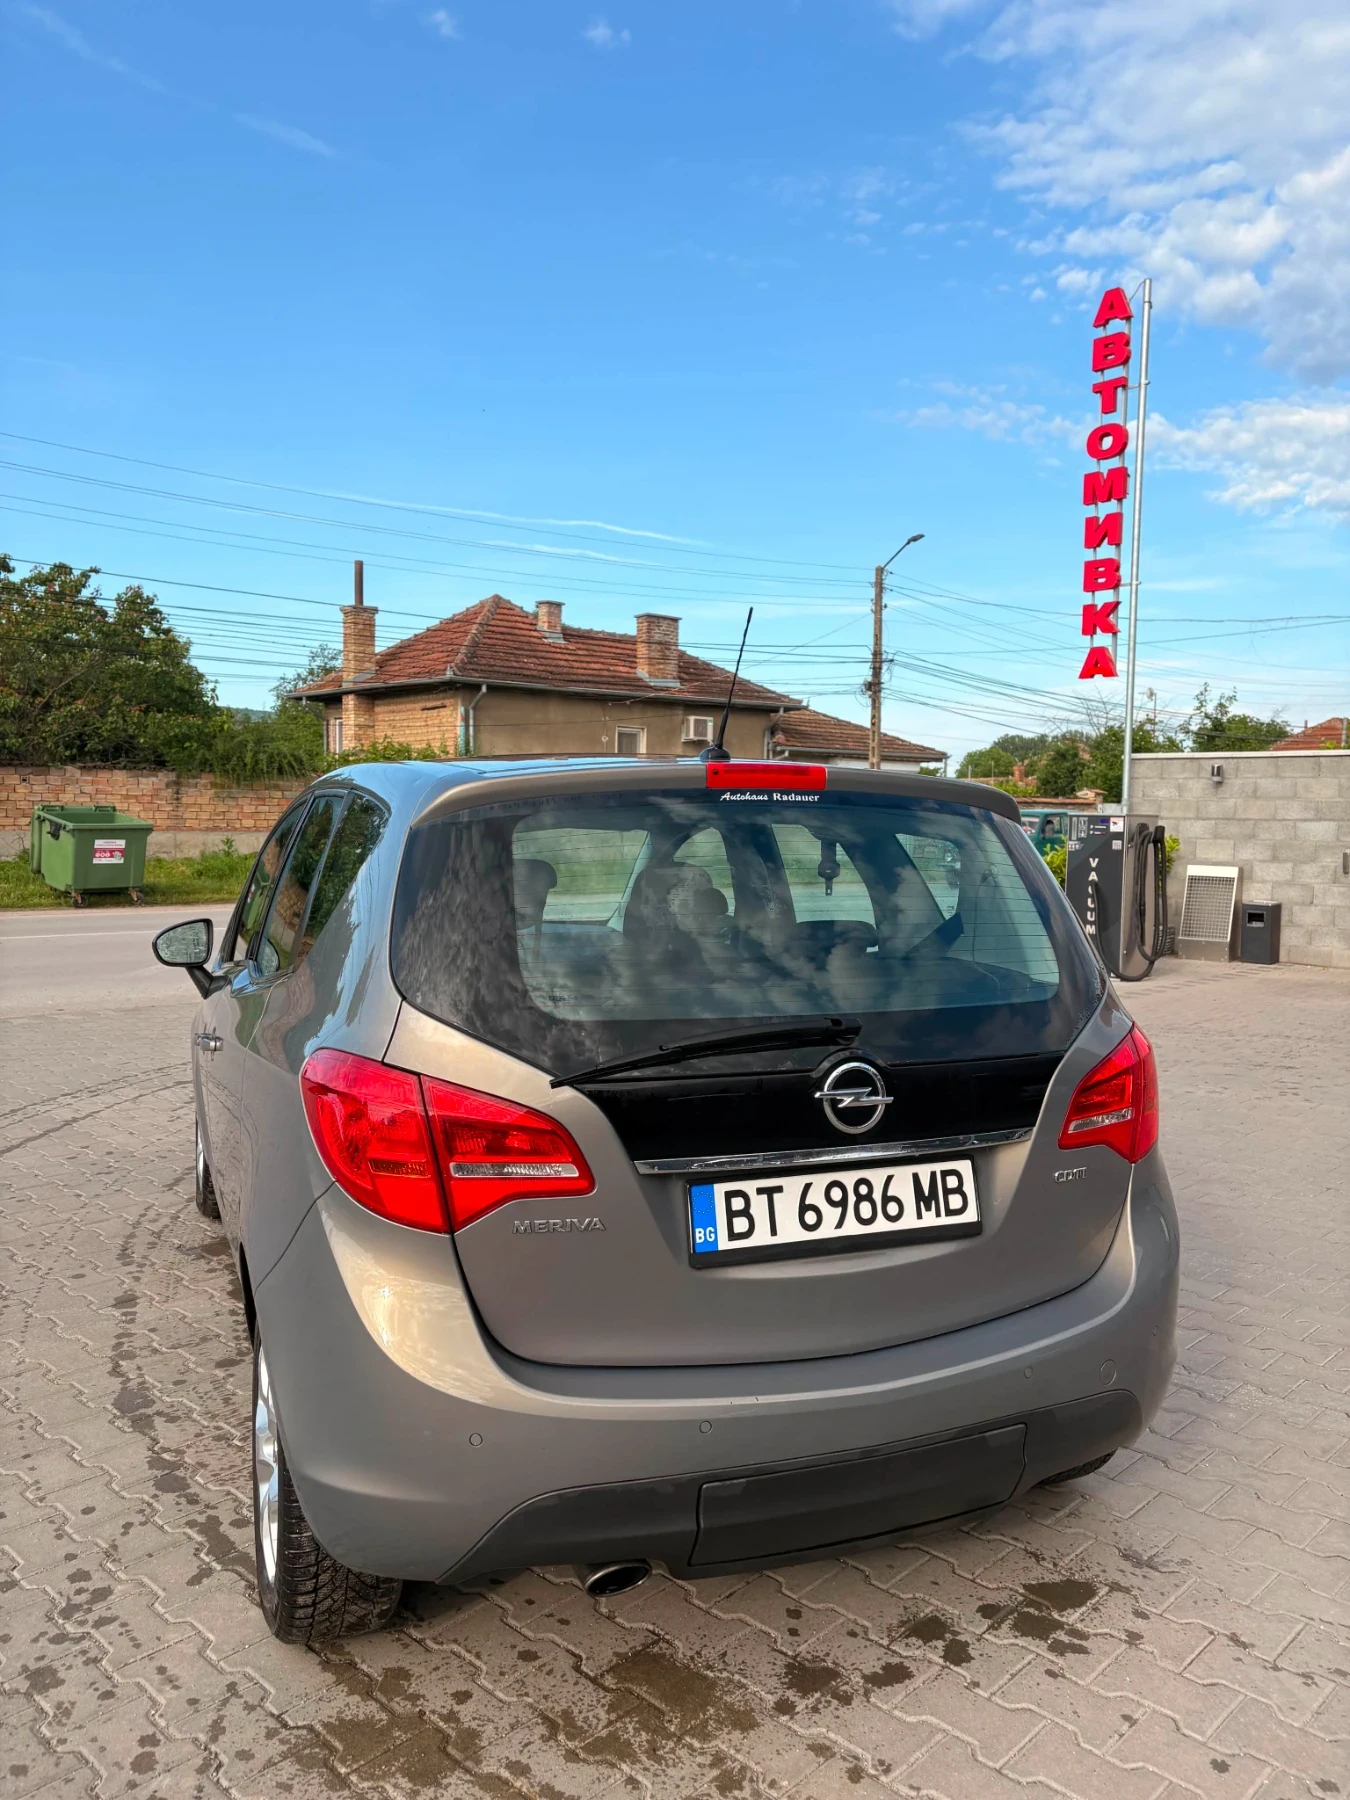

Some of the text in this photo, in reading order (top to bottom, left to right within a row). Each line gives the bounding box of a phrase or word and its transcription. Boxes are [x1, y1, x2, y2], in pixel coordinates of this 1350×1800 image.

[1078, 286, 1134, 680] АВТОМИВКА
[720, 791, 820, 802] Autohaus Radauer
[724, 1168, 969, 1242] BT 6986 MB
[513, 1217, 607, 1234] MERIVA
[695, 1227, 715, 1244] BG
